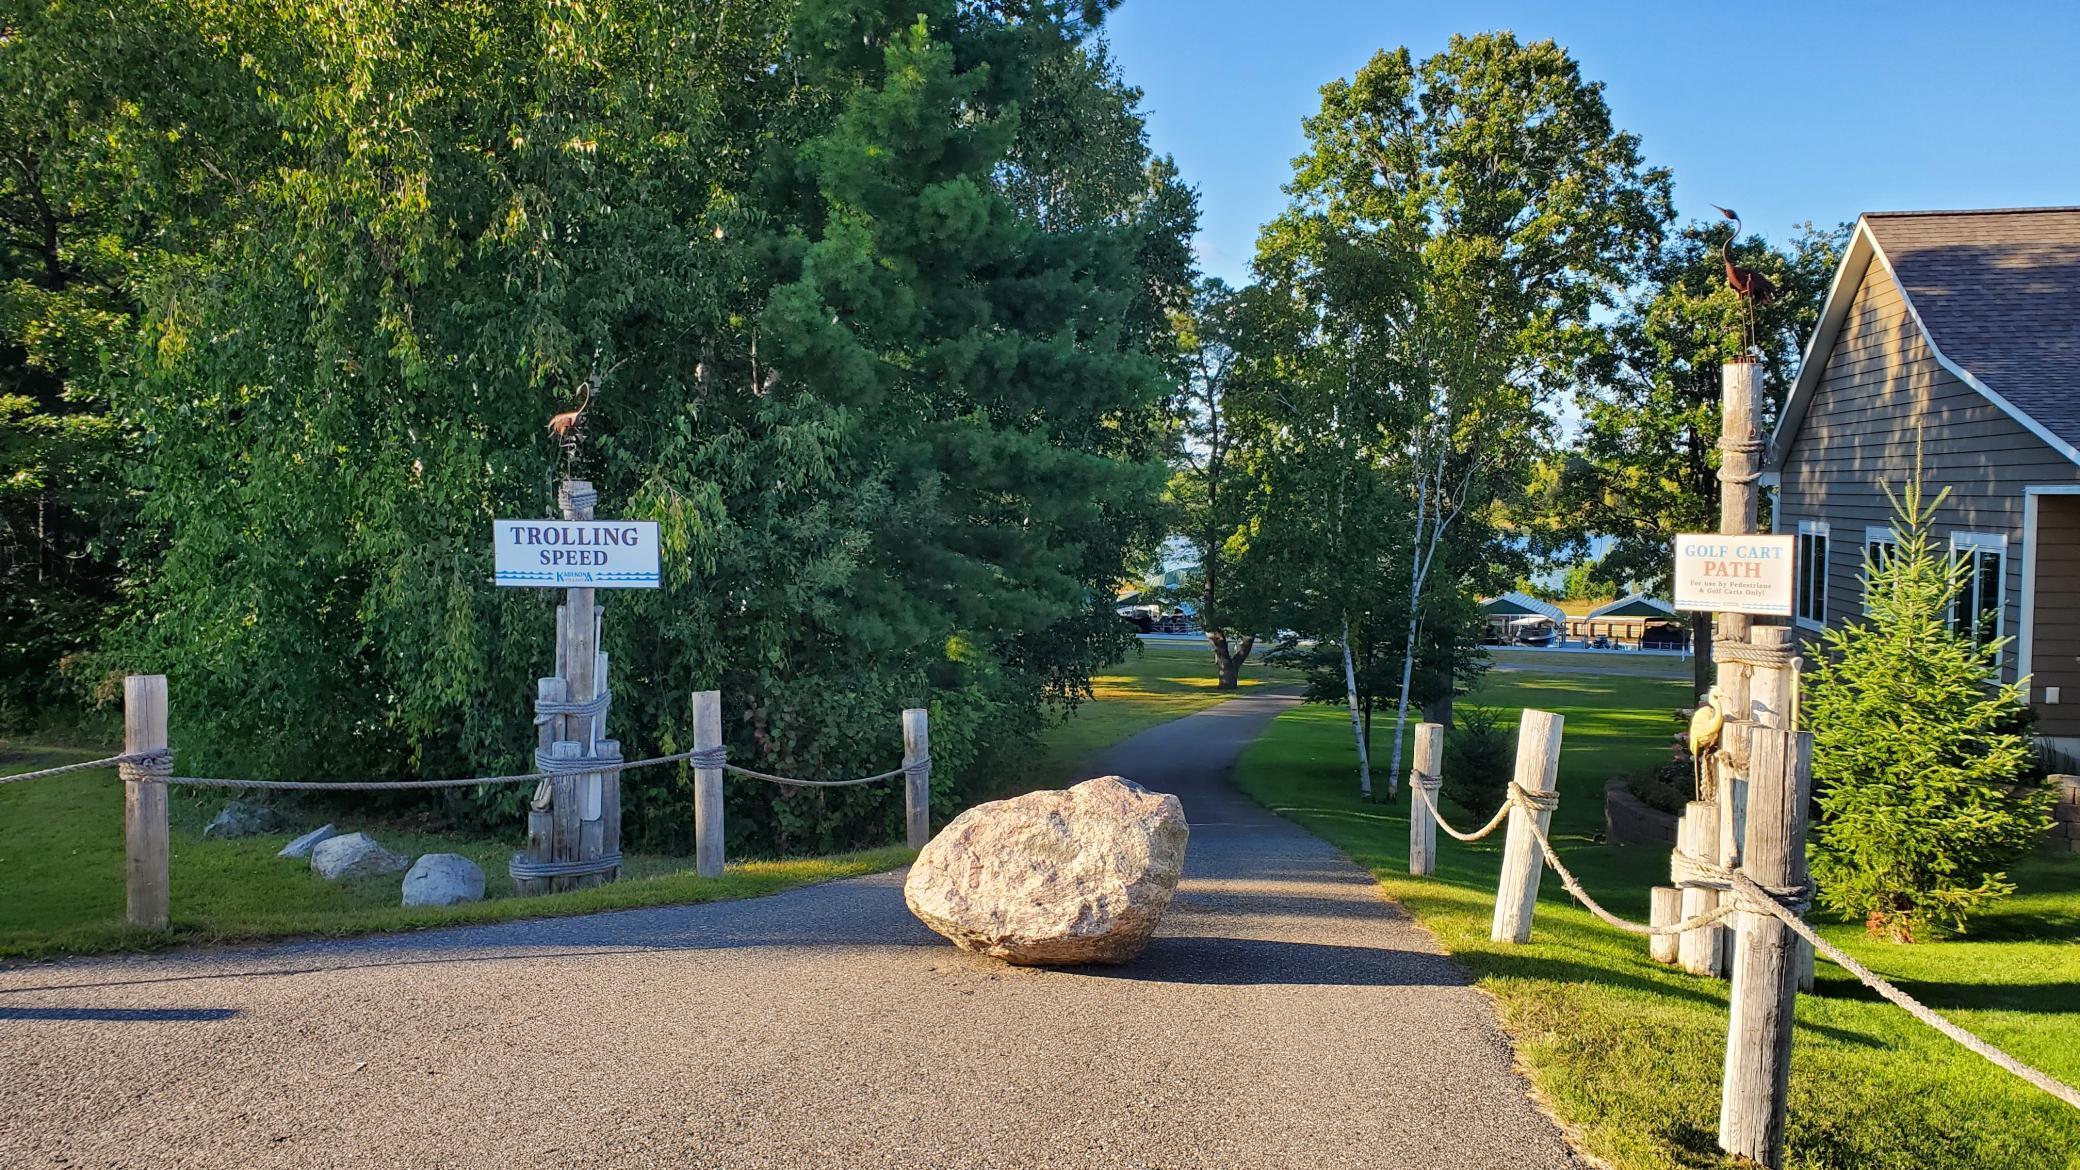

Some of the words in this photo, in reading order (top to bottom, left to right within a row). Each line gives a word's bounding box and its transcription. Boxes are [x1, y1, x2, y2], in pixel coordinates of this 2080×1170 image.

[510, 526, 639, 546] TROLLING
[540, 549, 608, 566] SPEED
[1685, 544, 1729, 558] GOLF
[1735, 545, 1783, 559] CART
[1703, 560, 1762, 578] PATH
[1729, 581, 1772, 589] Pedestrians
